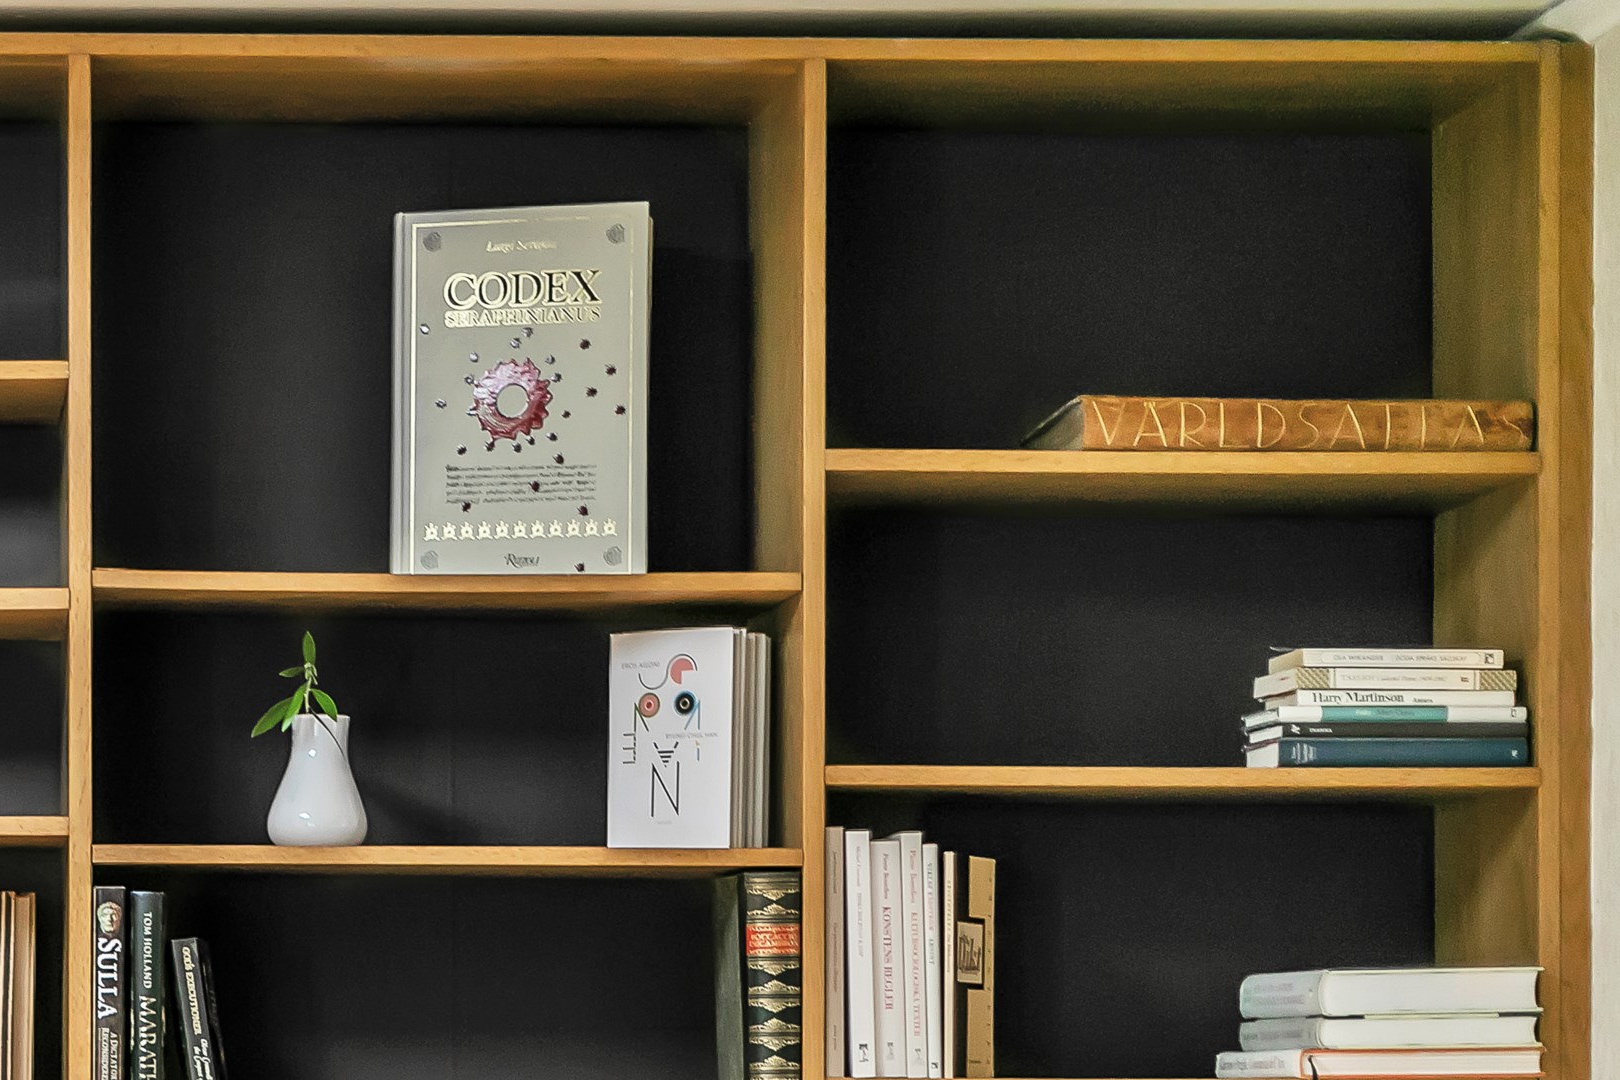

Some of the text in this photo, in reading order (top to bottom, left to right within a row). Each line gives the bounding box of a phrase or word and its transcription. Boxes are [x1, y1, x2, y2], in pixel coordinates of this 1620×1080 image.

[444, 268, 603, 310] CODEX
[1312, 692, 1404, 705] Harry Martinson
[142, 911, 153, 990] TOM HOLLAND
[882, 906, 893, 963] KONSTENS
[97, 937, 123, 1020] SULLA
